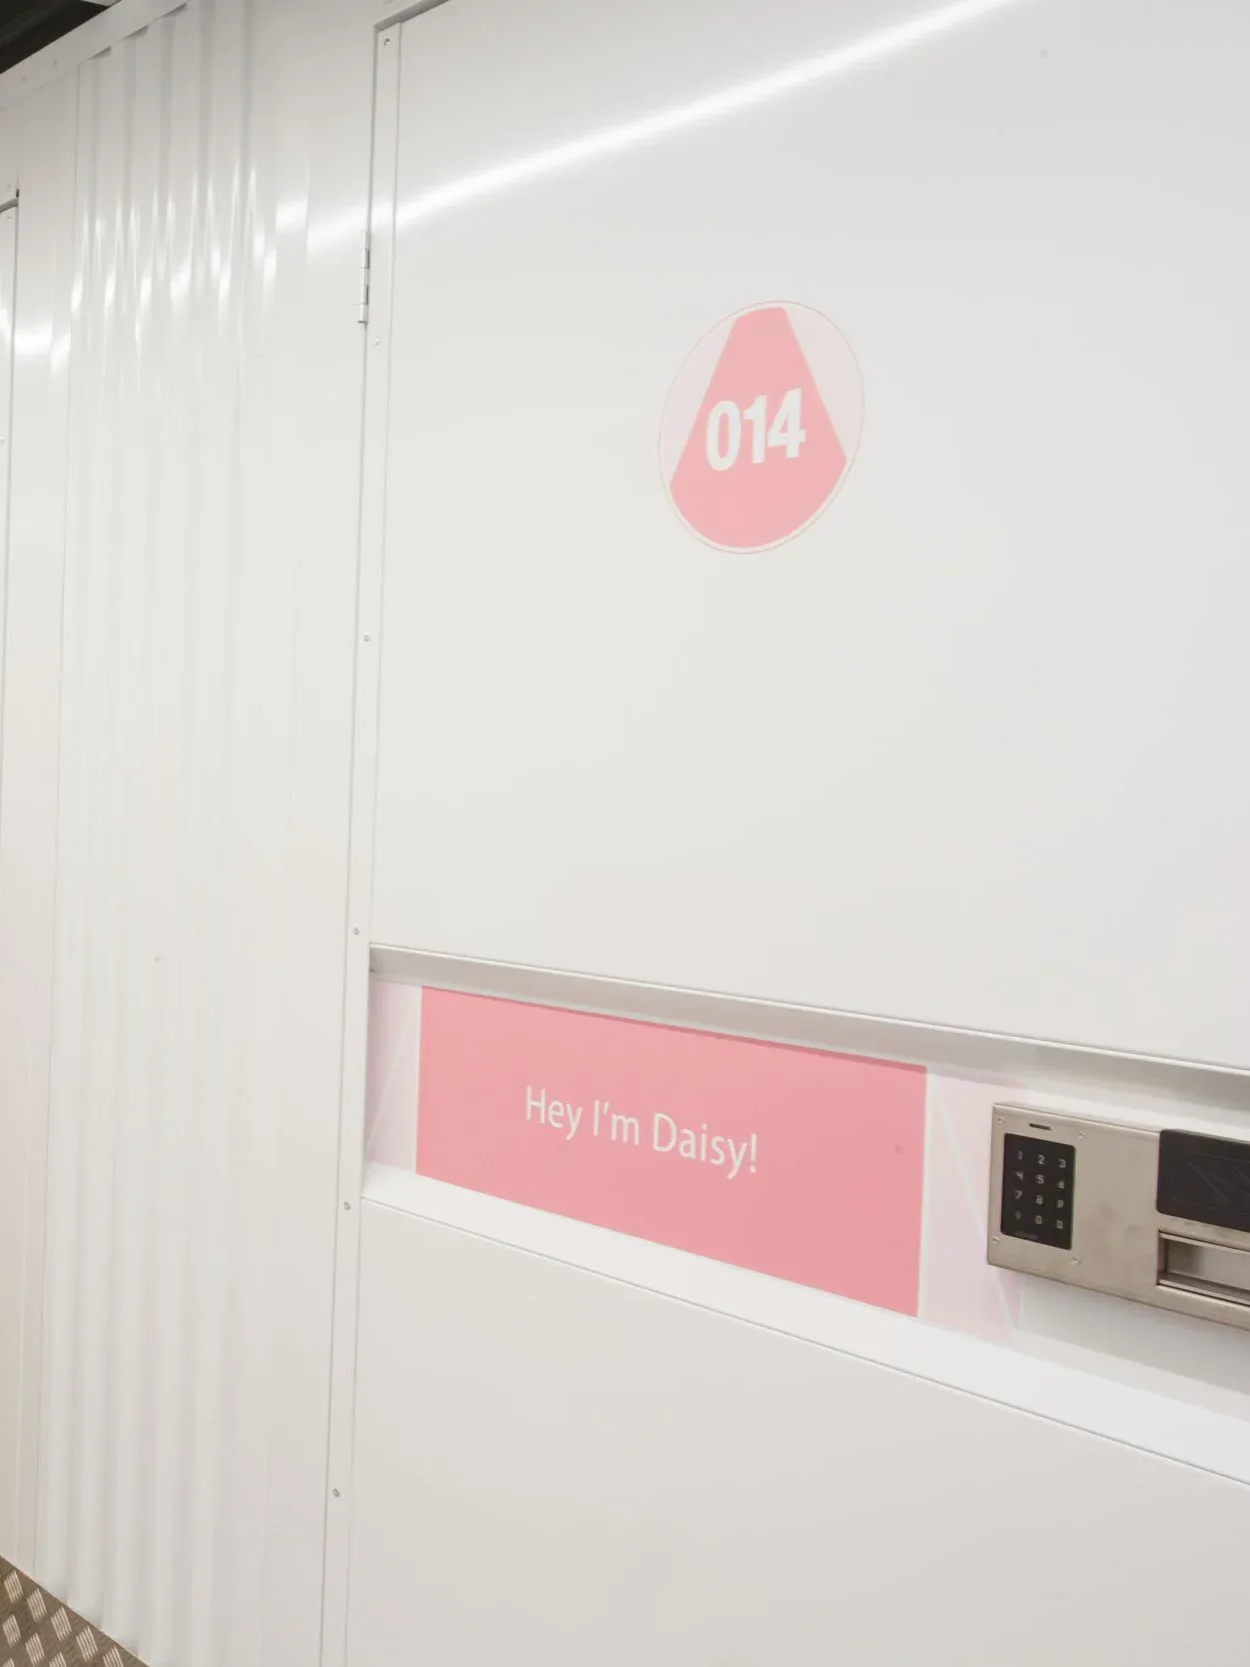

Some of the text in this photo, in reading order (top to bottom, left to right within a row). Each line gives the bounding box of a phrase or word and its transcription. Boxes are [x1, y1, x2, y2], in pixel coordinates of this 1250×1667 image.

[706, 388, 806, 471] 014
[525, 1085, 757, 1180] Hey I'm Daisy!
[1038, 1154, 1046, 1165] 2
[1058, 1158, 1067, 1169] 3
[1036, 1174, 1045, 1185] 5
[1014, 1189, 1065, 1209] 7 8 9
[1035, 1215, 1043, 1225] 0
